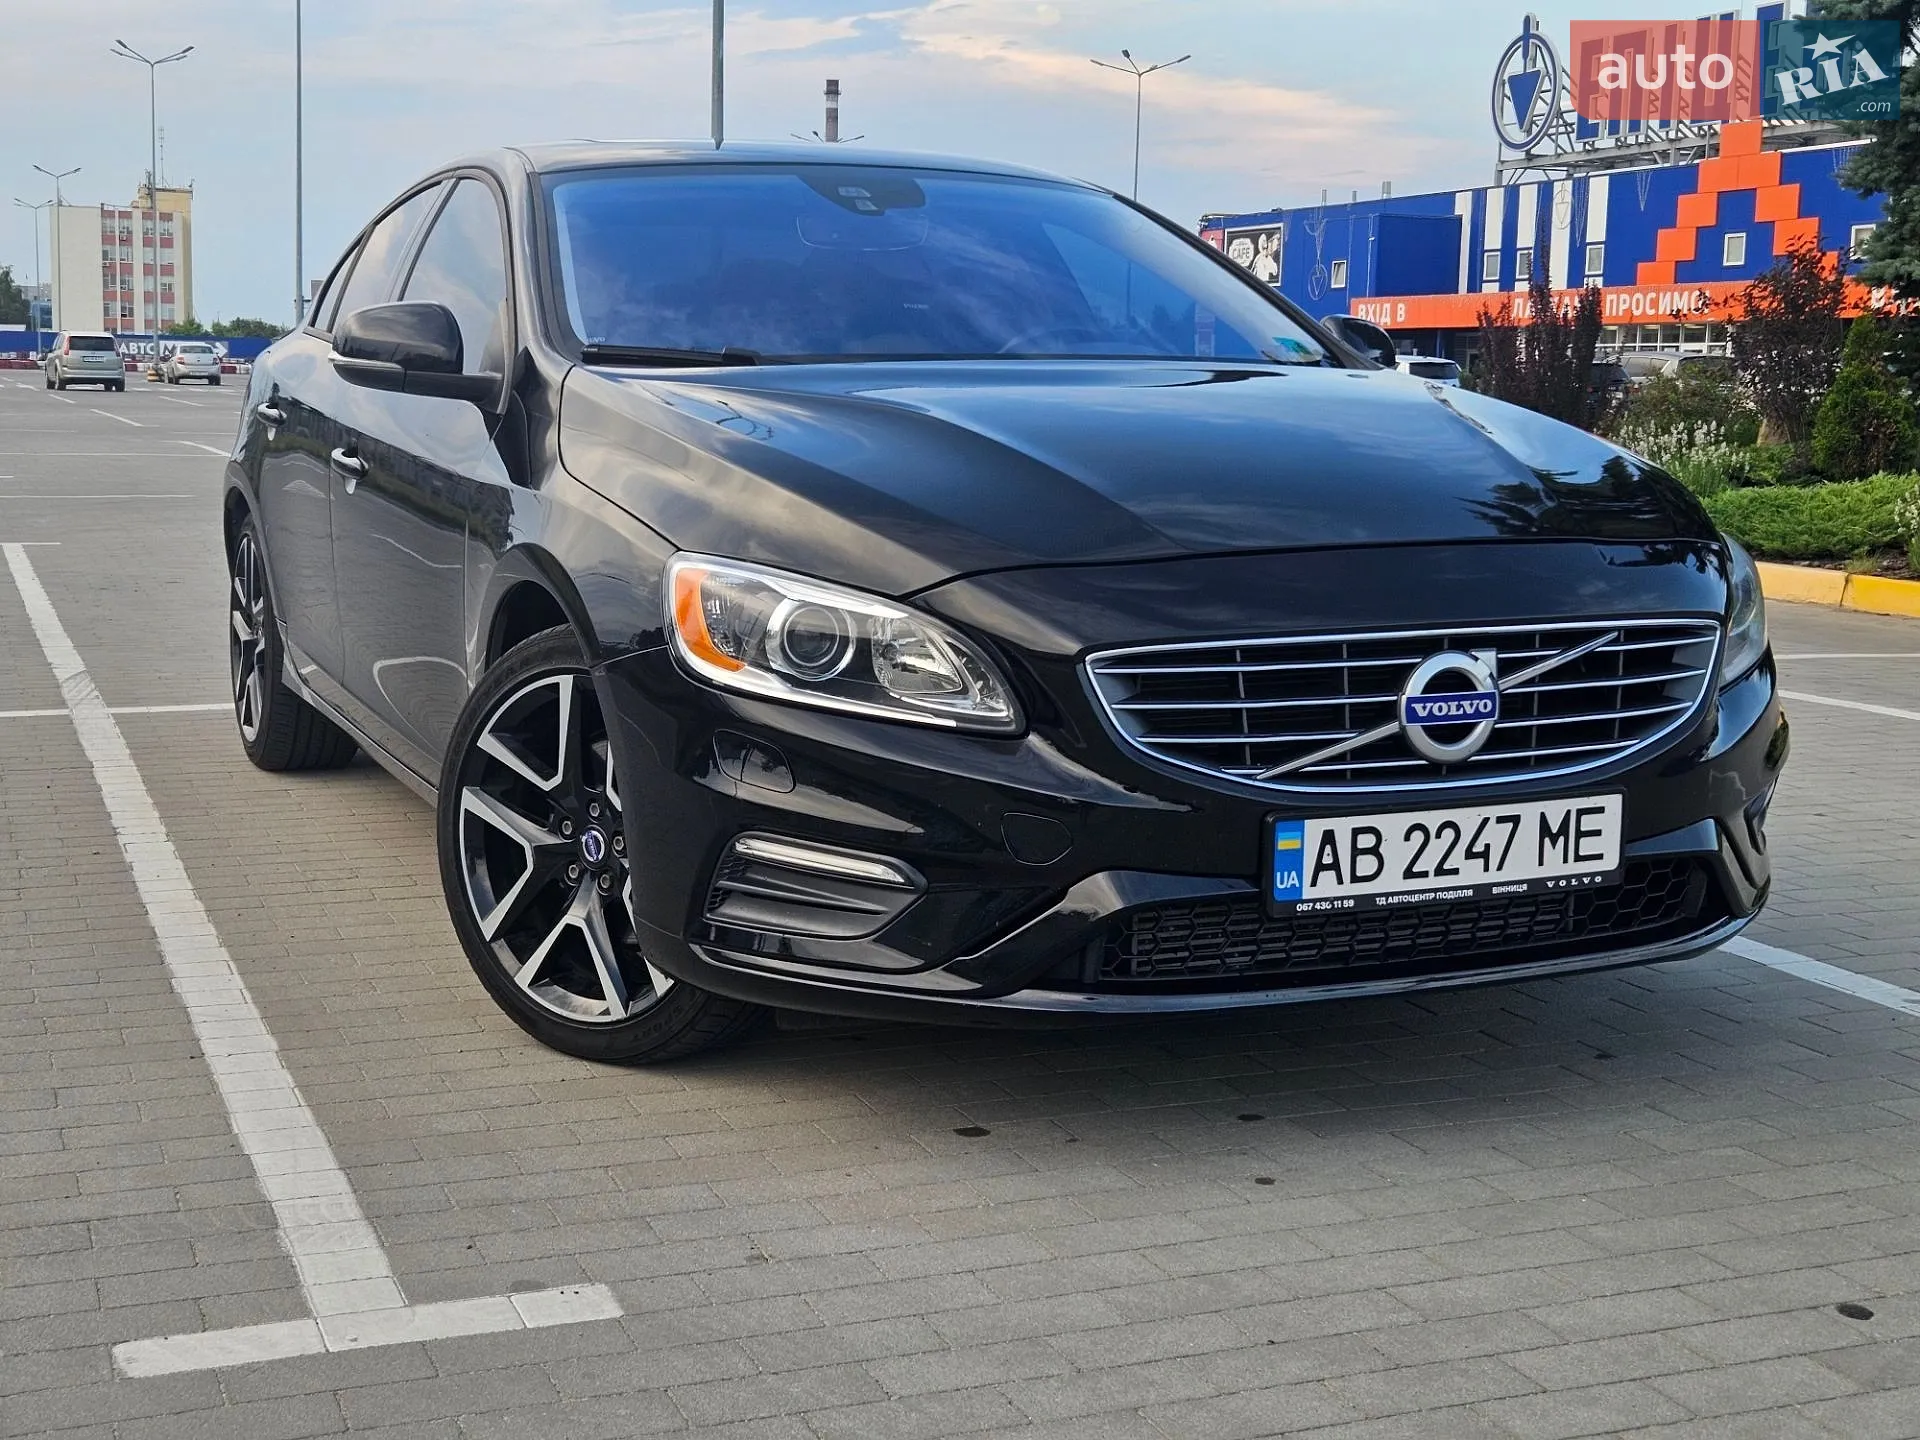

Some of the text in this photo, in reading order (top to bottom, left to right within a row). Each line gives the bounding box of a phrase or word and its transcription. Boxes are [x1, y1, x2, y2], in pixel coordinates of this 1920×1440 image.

[1358, 302, 1405, 326] ВХІД В
[1411, 699, 1493, 717] VOLVO
[1310, 806, 1606, 888] AB 2247 ME
[1276, 871, 1300, 889] UA
[1296, 902, 1314, 911] 067
[1333, 900, 1342, 908] 11
[1375, 897, 1387, 906] ТД
[1387, 892, 1436, 903] АВТОЦЕНТР
[1436, 889, 1474, 900] ПОДІЛЛЯ
[1492, 883, 1528, 894] ВІННИЦЯ
[1545, 875, 1603, 888] VOLVO
